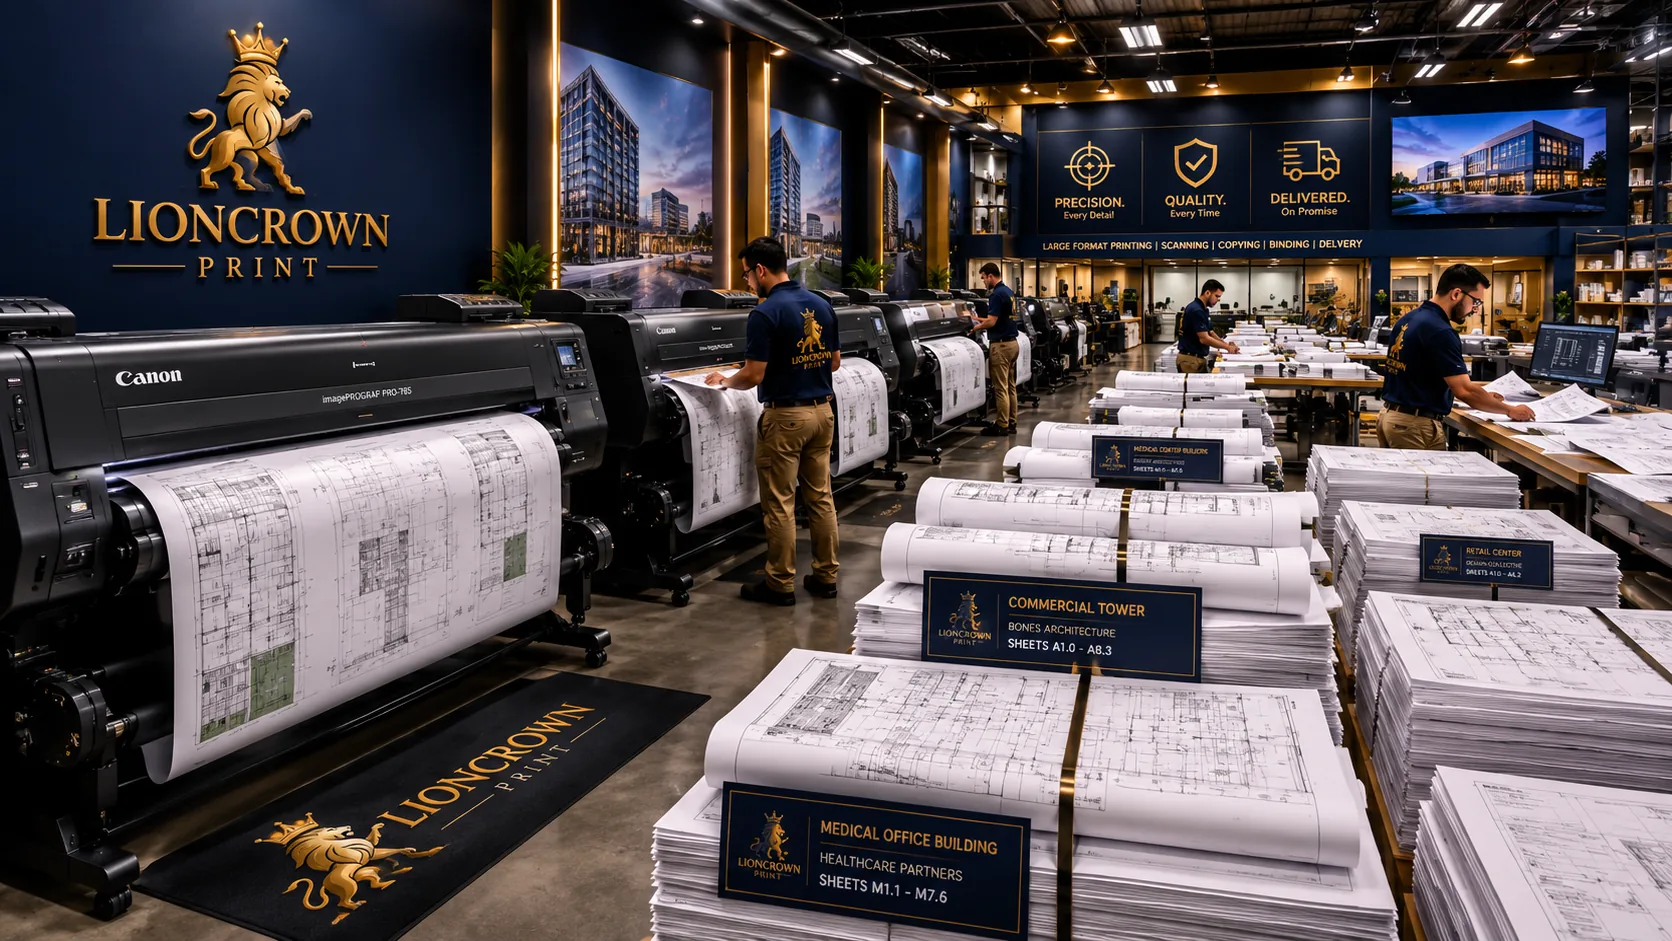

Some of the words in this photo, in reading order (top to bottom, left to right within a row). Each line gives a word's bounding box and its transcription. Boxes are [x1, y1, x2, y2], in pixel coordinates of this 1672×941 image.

[1055, 197, 1125, 208] PRECISION.
[1165, 194, 1226, 207] QUALITY.
[1270, 192, 1350, 204] DELIVERED.
[1063, 211, 1087, 220] Every
[1089, 210, 1115, 219] Detail
[1170, 209, 1195, 219] Every
[1198, 208, 1220, 217] Time
[1281, 207, 1295, 216] On
[1298, 206, 1338, 216] Promise
[93, 198, 390, 248] LIONCROWN
[1043, 242, 1070, 251] LARGE
[1073, 242, 1108, 250] FORMAT
[1110, 241, 1152, 250] PRINTING
[1161, 241, 1209, 250] SCANNING
[1218, 240, 1260, 249] COPYING
[1269, 240, 1310, 249] BINDING
[198, 256, 318, 278] PRINT
[115, 369, 182, 387] Canon
[1466, 547, 1491, 556] RETAIL
[1008, 596, 1095, 614] COMMERCIAL
[1098, 602, 1145, 617] TOWER
[1008, 621, 1041, 633] BONES
[1043, 624, 1116, 638] ARCHITECTURE
[1008, 638, 1049, 651] SHEETS
[1052, 641, 1076, 653] A1.0
[1086, 644, 1112, 656] A8.3
[376, 702, 595, 828] LIONCROWN
[494, 744, 570, 792] PRINT
[820, 820, 880, 841] MEDICAL
[883, 828, 931, 847] OFFICE
[934, 834, 998, 855] BUILDING
[737, 857, 801, 874] LIONCROWN
[819, 852, 897, 874] HEALTHCARE
[900, 862, 963, 882] PARTNERS
[819, 873, 868, 892] SHEETS
[871, 880, 900, 897] M1.1
[915, 887, 948, 904] M7.6
